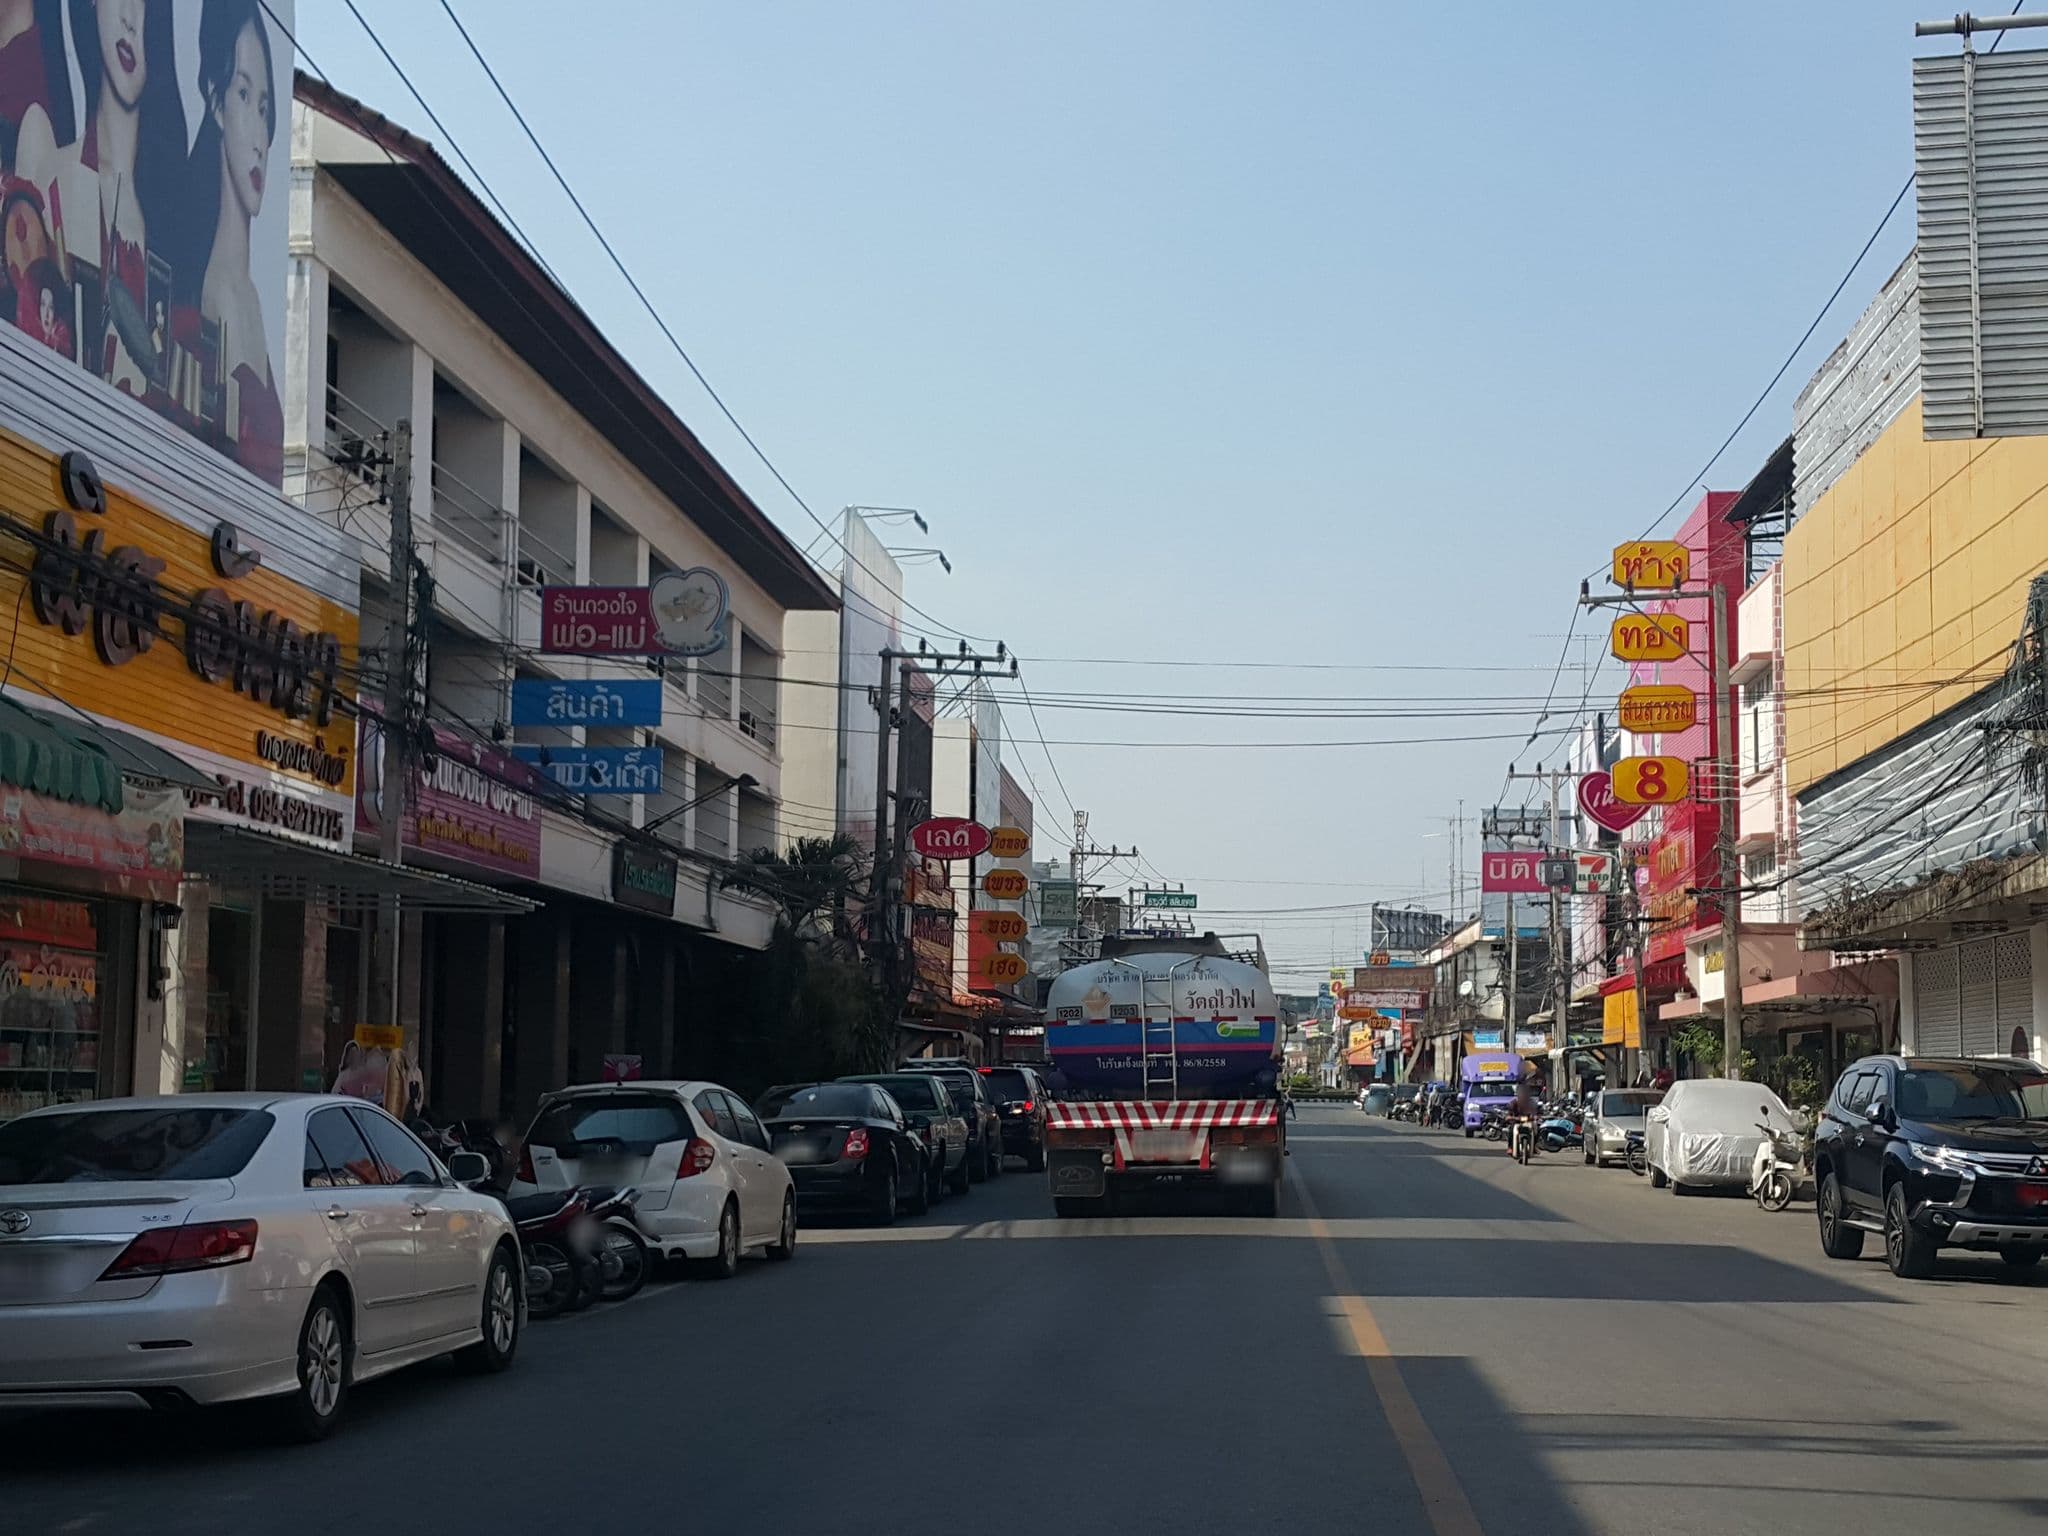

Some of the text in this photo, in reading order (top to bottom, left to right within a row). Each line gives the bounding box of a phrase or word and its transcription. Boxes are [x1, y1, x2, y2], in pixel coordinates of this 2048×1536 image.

[1620, 546, 1684, 580] ห้าง
[553, 592, 638, 615] ร้านดวงใจ
[552, 616, 647, 649] พ่อ-แม่
[1619, 625, 1683, 650] ทอง
[546, 685, 624, 719] สินค้า
[1635, 760, 1667, 802] 8
[1060, 1008, 1135, 1017] 1202 1203
[1185, 988, 1255, 1016] วัตถุไวไฟ
